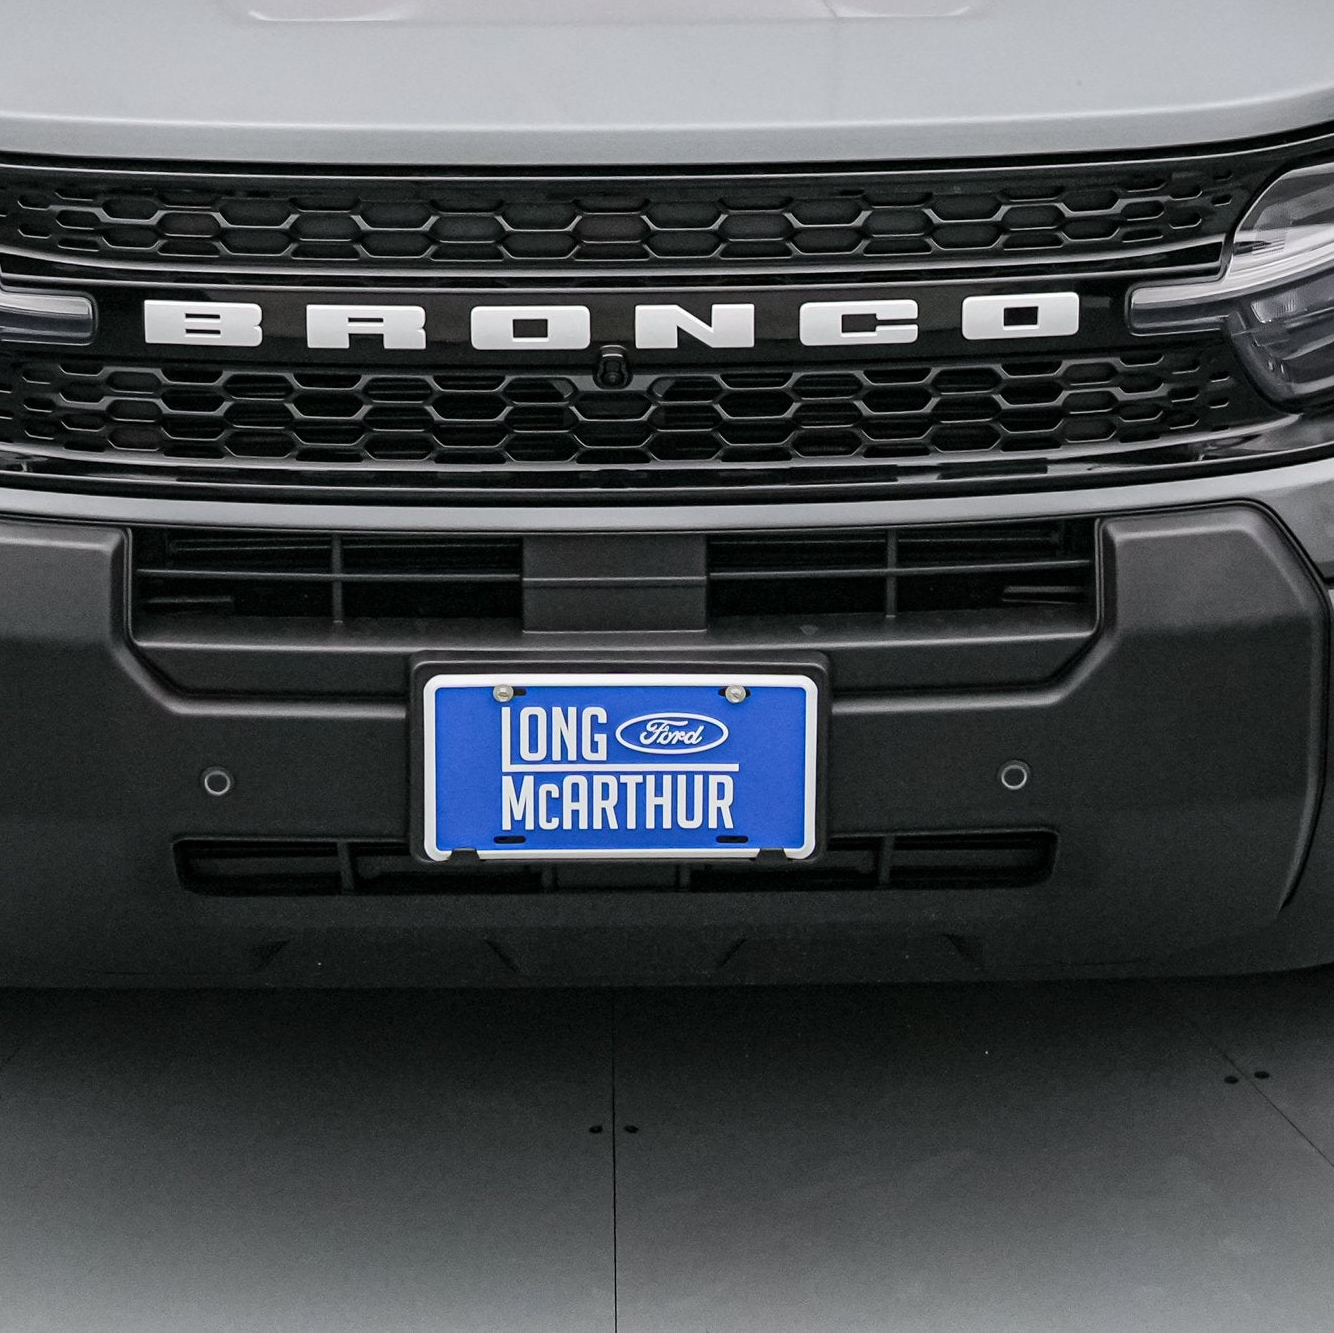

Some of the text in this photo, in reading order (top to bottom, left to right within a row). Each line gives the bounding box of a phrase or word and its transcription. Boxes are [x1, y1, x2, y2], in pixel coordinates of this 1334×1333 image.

[143, 291, 1080, 350] BRONCO
[501, 706, 608, 762] LONG
[638, 718, 706, 746] Ford
